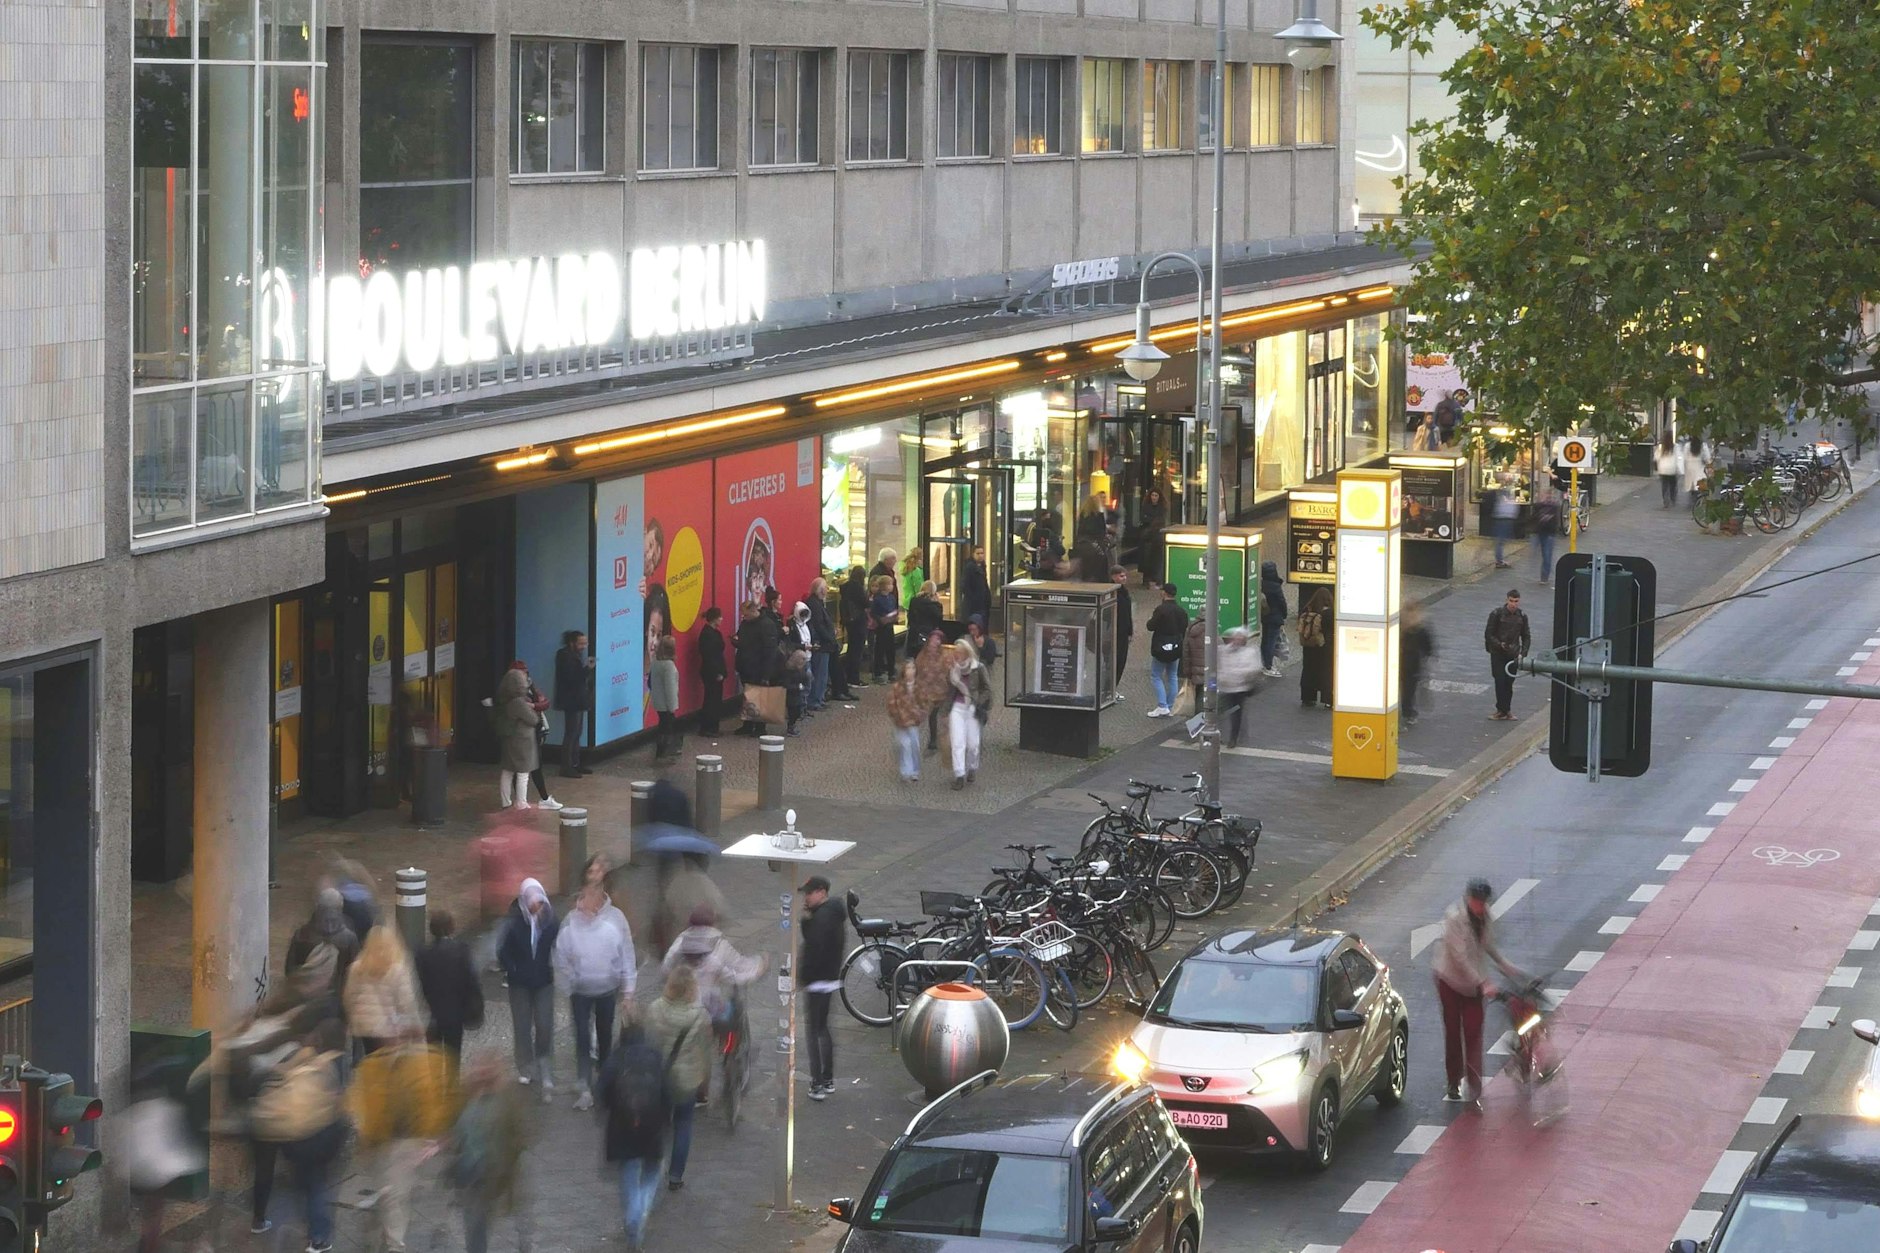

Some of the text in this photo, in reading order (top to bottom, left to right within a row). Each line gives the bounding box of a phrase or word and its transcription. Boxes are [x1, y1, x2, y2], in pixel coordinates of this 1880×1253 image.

[327, 238, 767, 381] BOULEVARD BERLIN
[1569, 446, 1580, 458] H
[728, 474, 777, 504] CLEVERES
[1188, 573, 1224, 581] DEICHN
[1354, 732, 1366, 740] BVG
[1172, 1112, 1223, 1126] B AO 920
